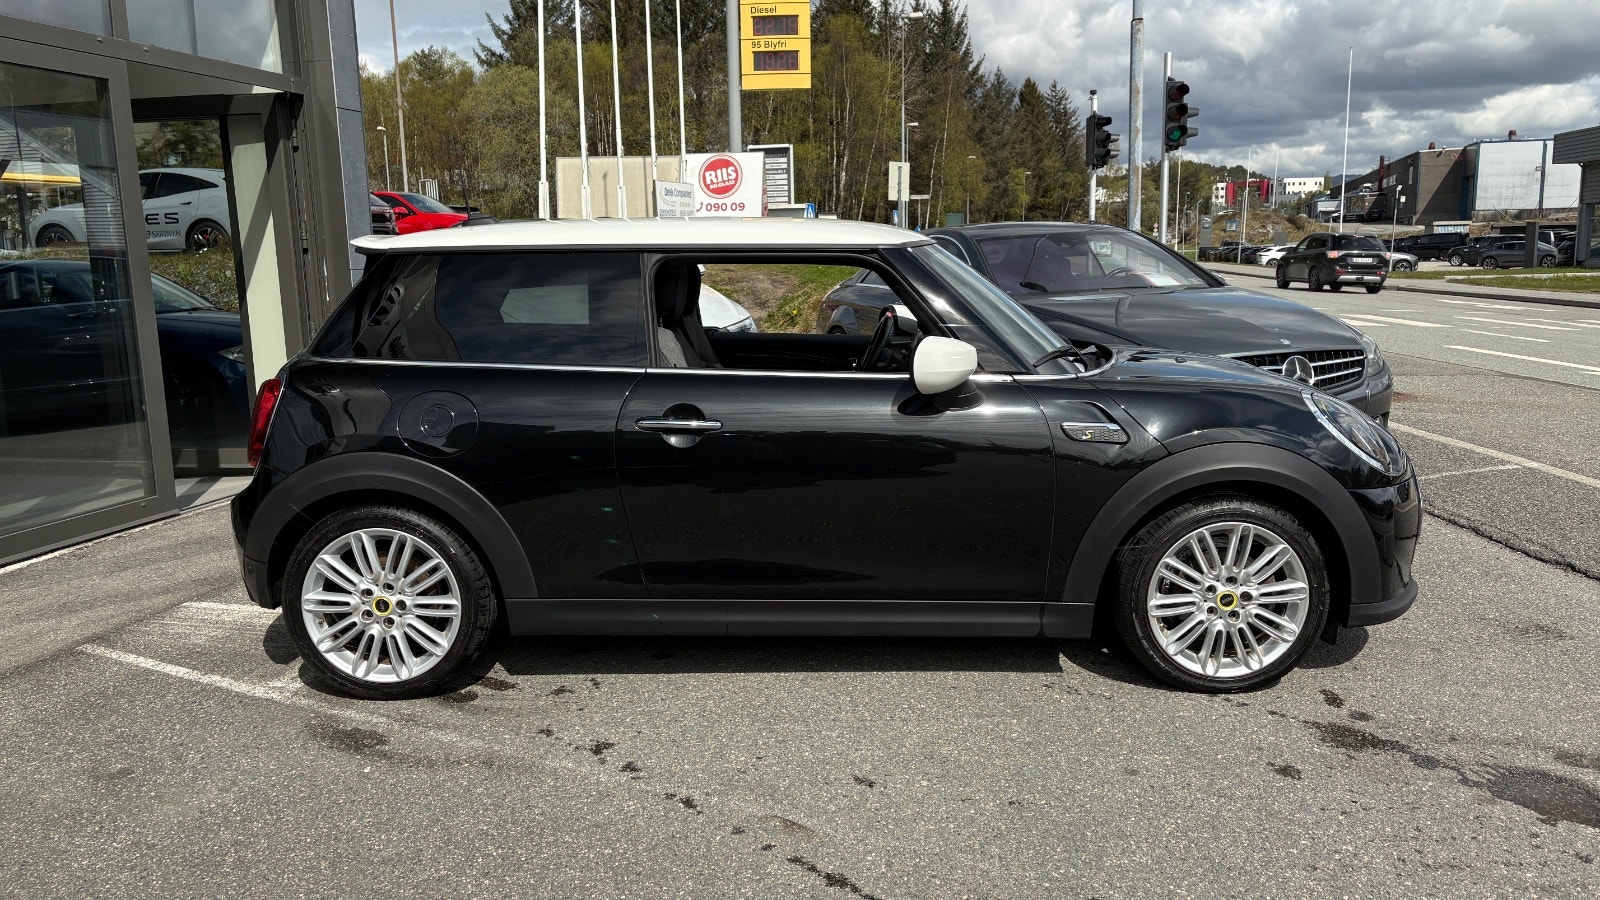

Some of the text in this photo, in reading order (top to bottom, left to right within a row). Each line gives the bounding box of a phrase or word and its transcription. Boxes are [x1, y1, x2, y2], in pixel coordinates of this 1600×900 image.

[750, 5, 777, 14] Diesel
[751, 40, 787, 50] 95 Blyfri
[704, 166, 737, 185] RIIS
[705, 202, 745, 212] 090 09
